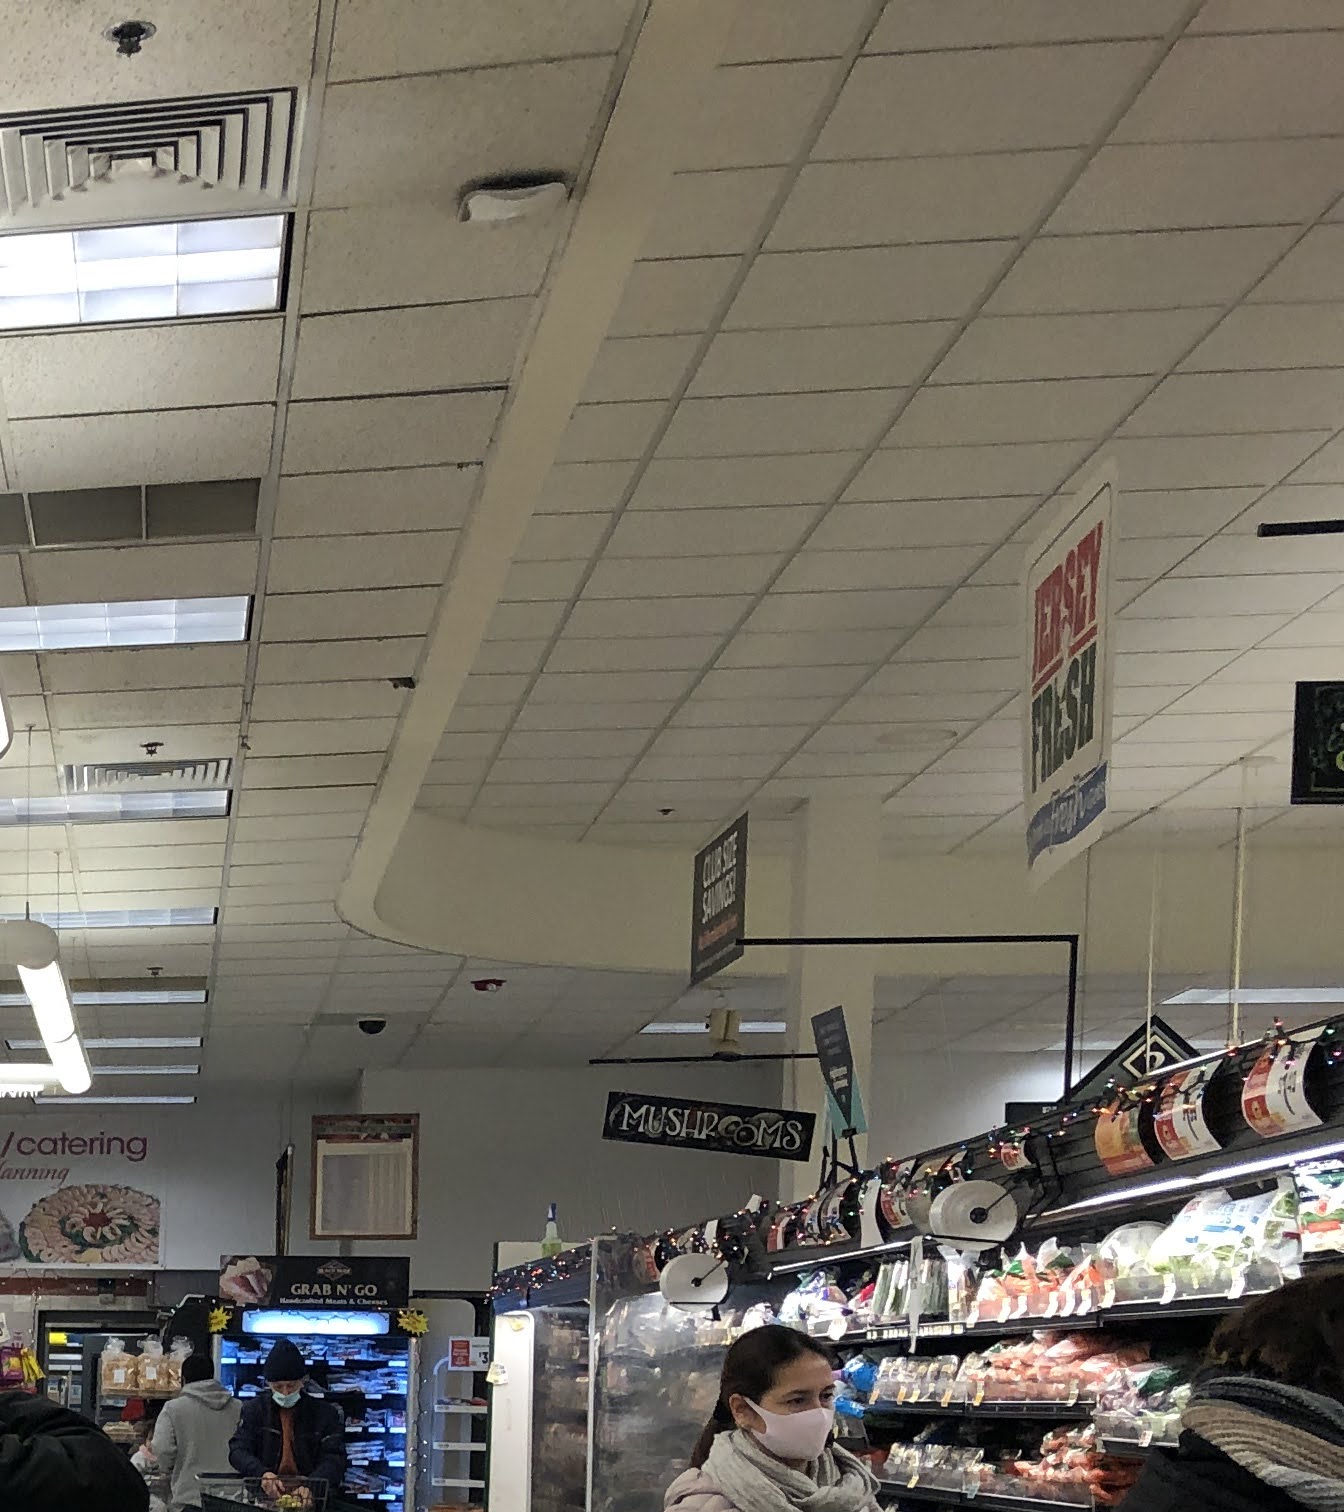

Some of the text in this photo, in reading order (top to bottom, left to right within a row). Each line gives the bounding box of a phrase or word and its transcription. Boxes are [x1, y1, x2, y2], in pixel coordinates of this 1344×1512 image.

[1032, 641, 1097, 794] FRESH
[618, 1102, 802, 1150] MUSHROOMS
[290, 1284, 332, 1296] GRAB
[354, 1284, 378, 1297] GO
